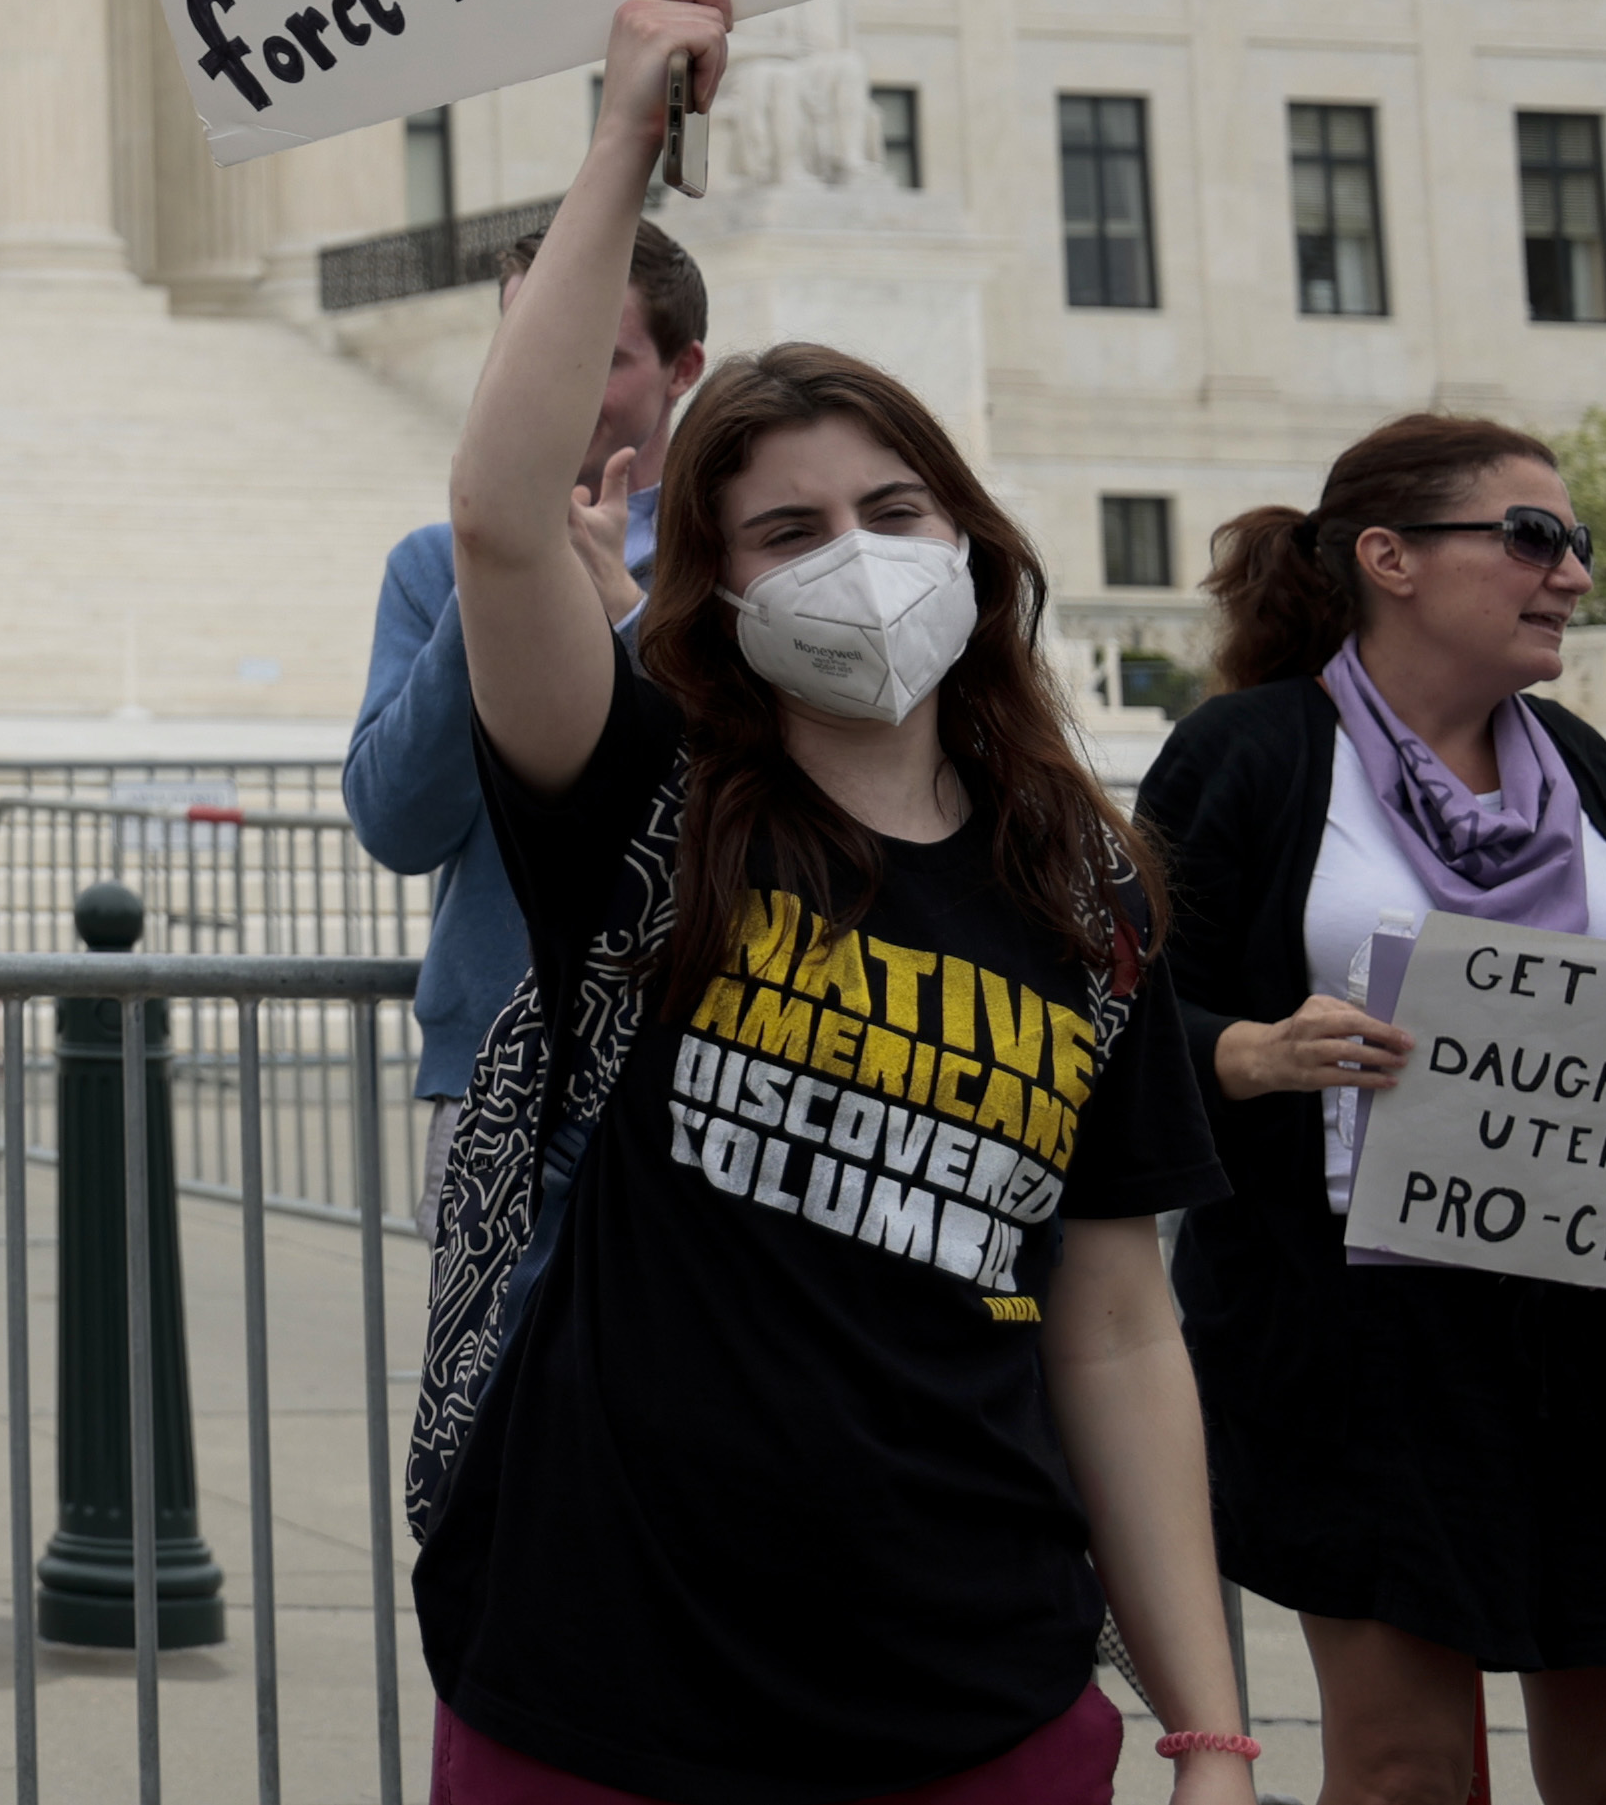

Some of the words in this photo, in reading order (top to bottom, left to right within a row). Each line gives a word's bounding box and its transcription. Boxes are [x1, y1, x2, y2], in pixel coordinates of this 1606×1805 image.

[793, 637, 864, 662] Honeywell
[720, 888, 1096, 1111] NATIVE
[1465, 946, 1598, 1007] GET
[689, 976, 1079, 1173] AMERICANS
[1429, 1035, 1606, 1104] DAUG
[671, 1033, 1064, 1225] DISCOVERED
[1478, 1109, 1606, 1169] UTE
[1398, 1170, 1606, 1262] PRO-C
